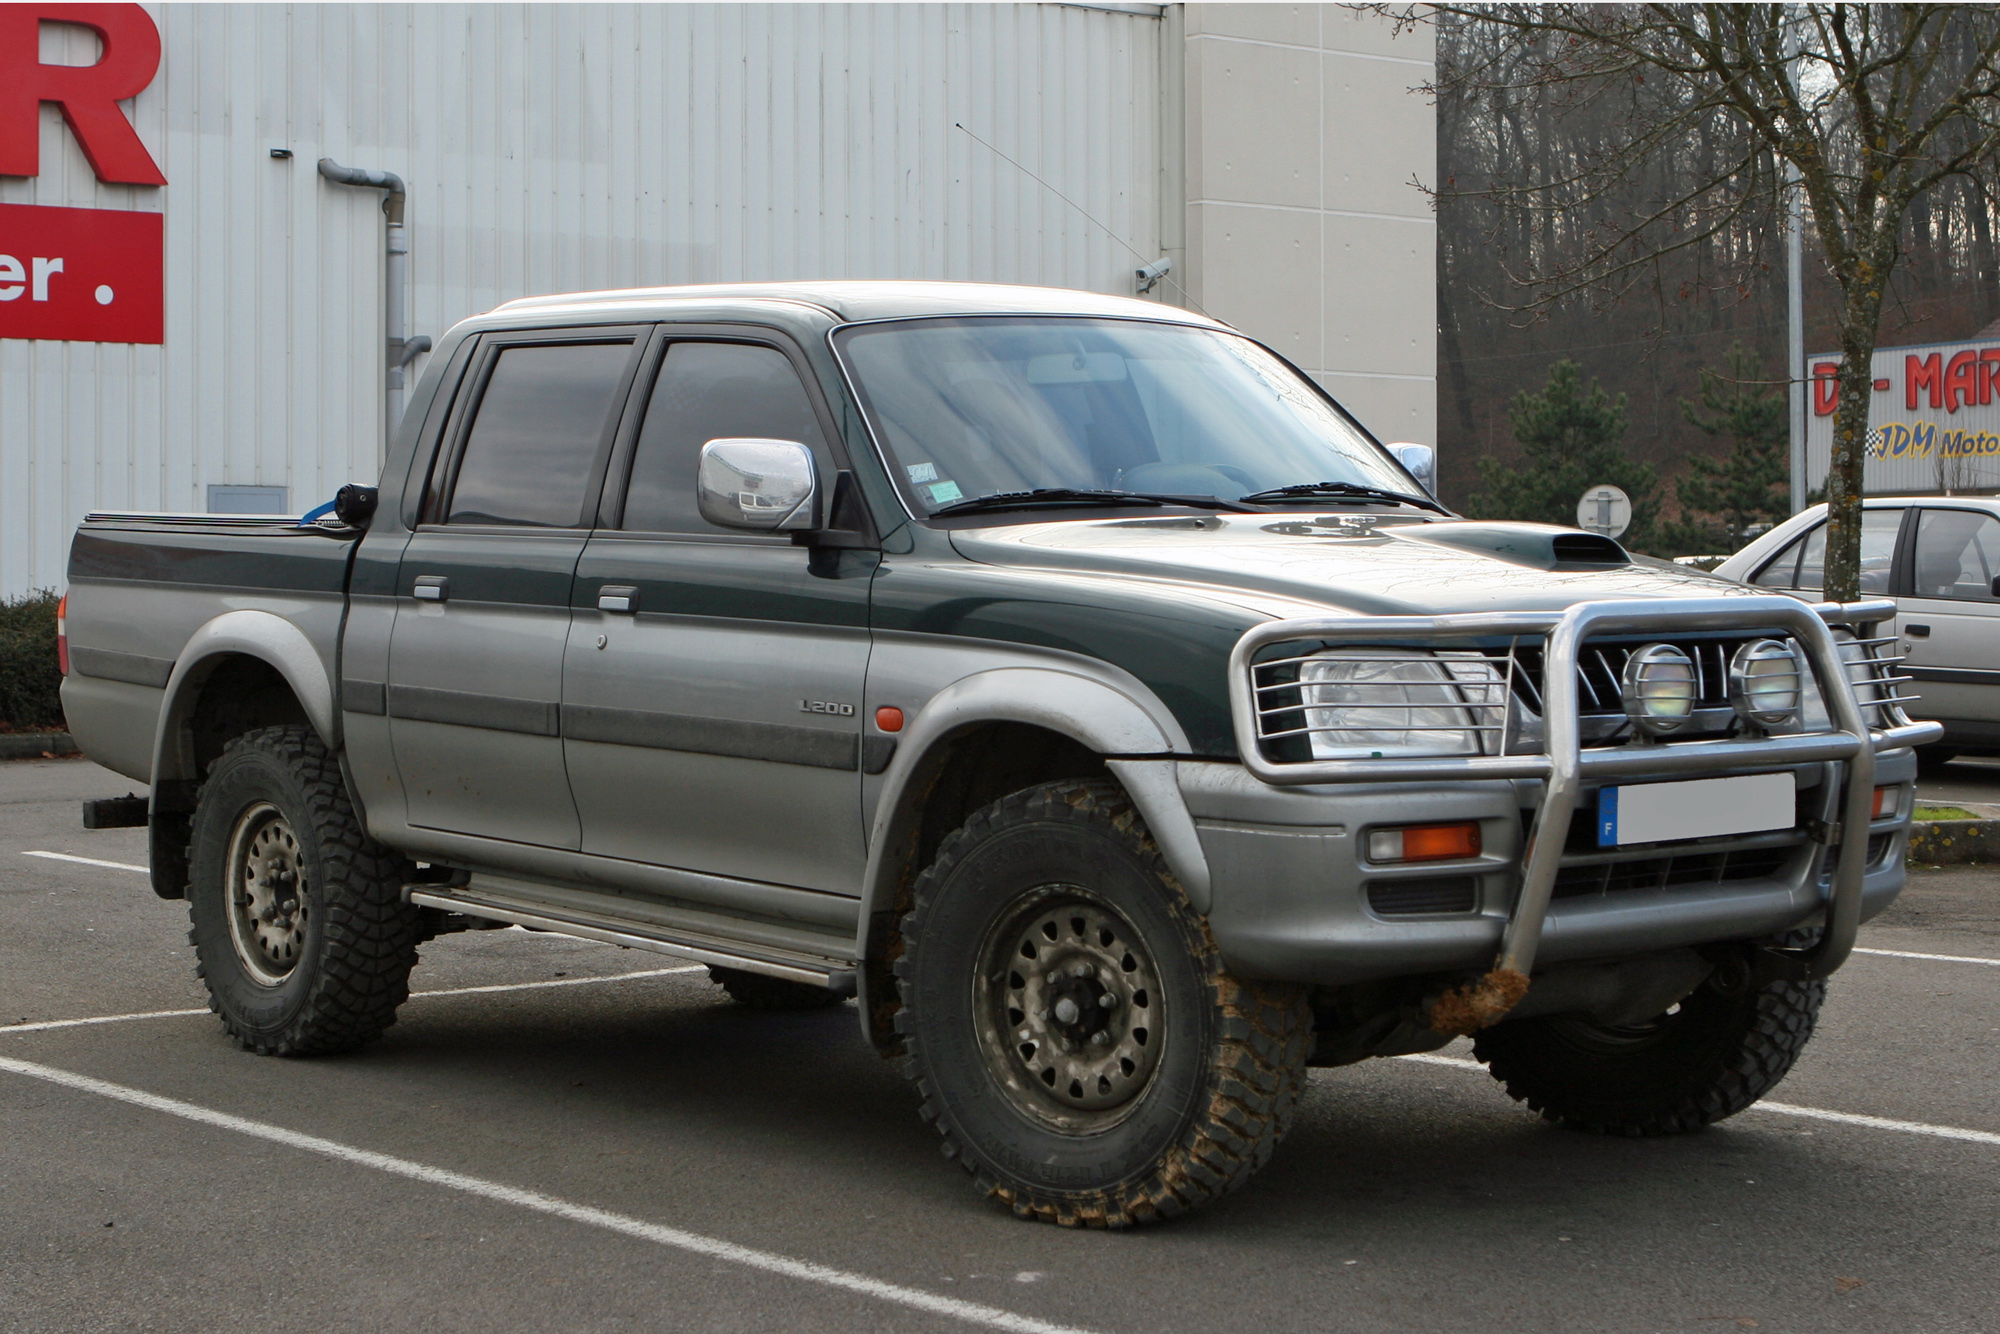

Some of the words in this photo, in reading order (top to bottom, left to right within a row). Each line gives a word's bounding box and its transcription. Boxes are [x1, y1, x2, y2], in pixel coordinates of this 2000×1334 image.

[0, 3, 168, 185] R
[1905, 348, 2000, 414] MAR
[1875, 420, 1937, 460] JDM
[799, 700, 855, 716] L200
[1604, 822, 1613, 836] F
